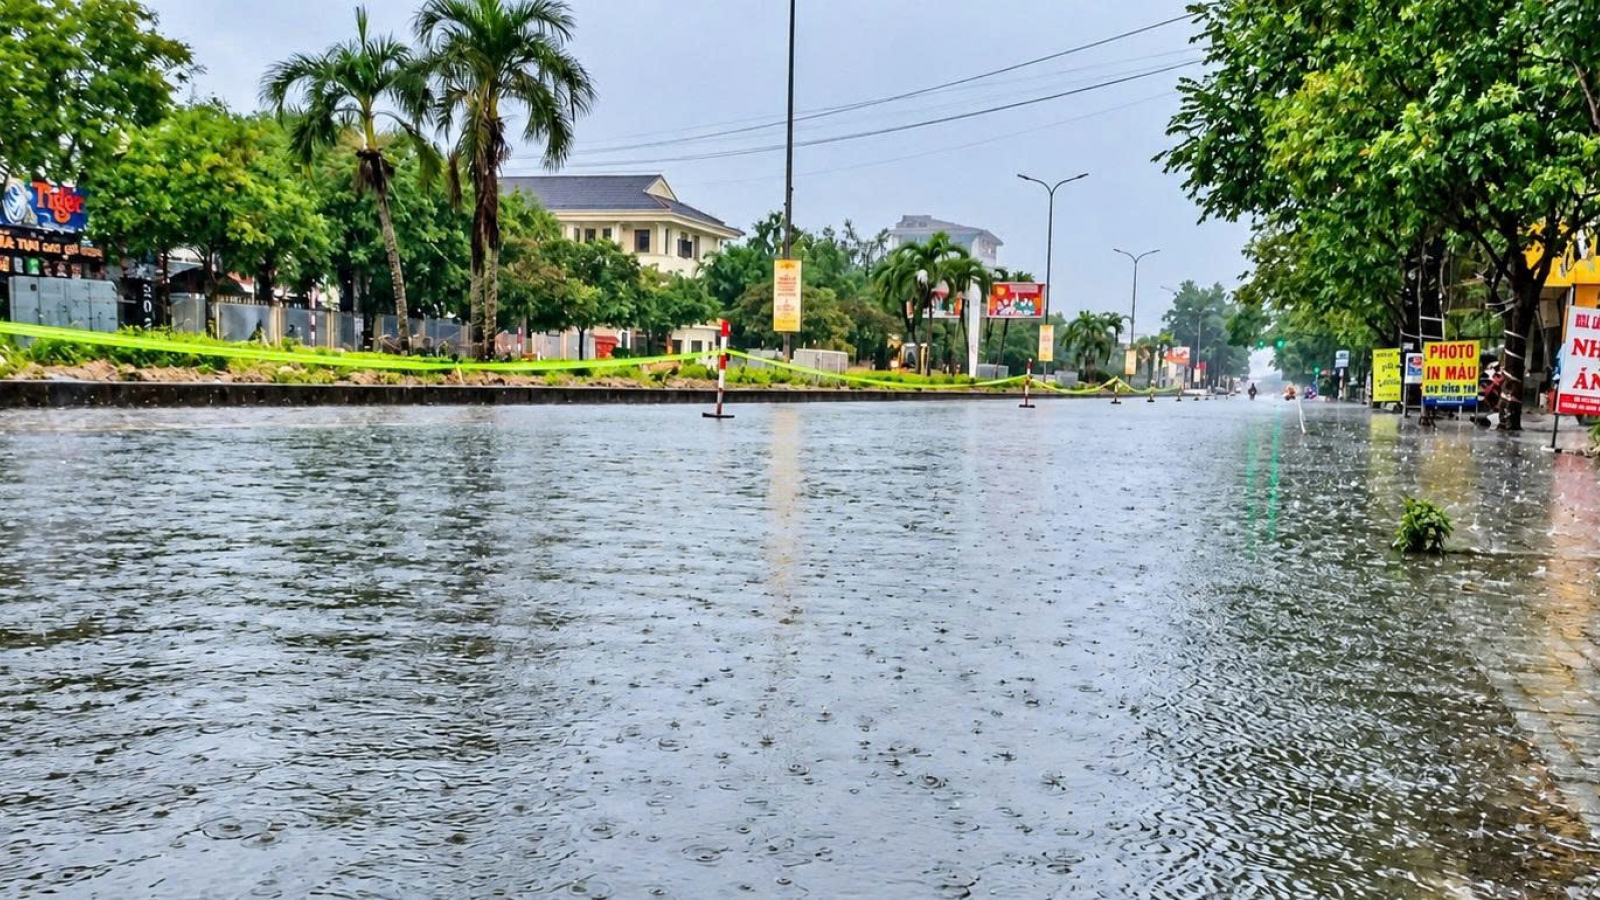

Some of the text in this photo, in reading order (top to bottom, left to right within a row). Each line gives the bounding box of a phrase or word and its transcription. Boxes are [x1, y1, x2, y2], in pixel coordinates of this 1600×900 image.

[32, 182, 84, 223] Tiger
[1430, 344, 1474, 359] PHOTO
[1427, 366, 1441, 380] IN
